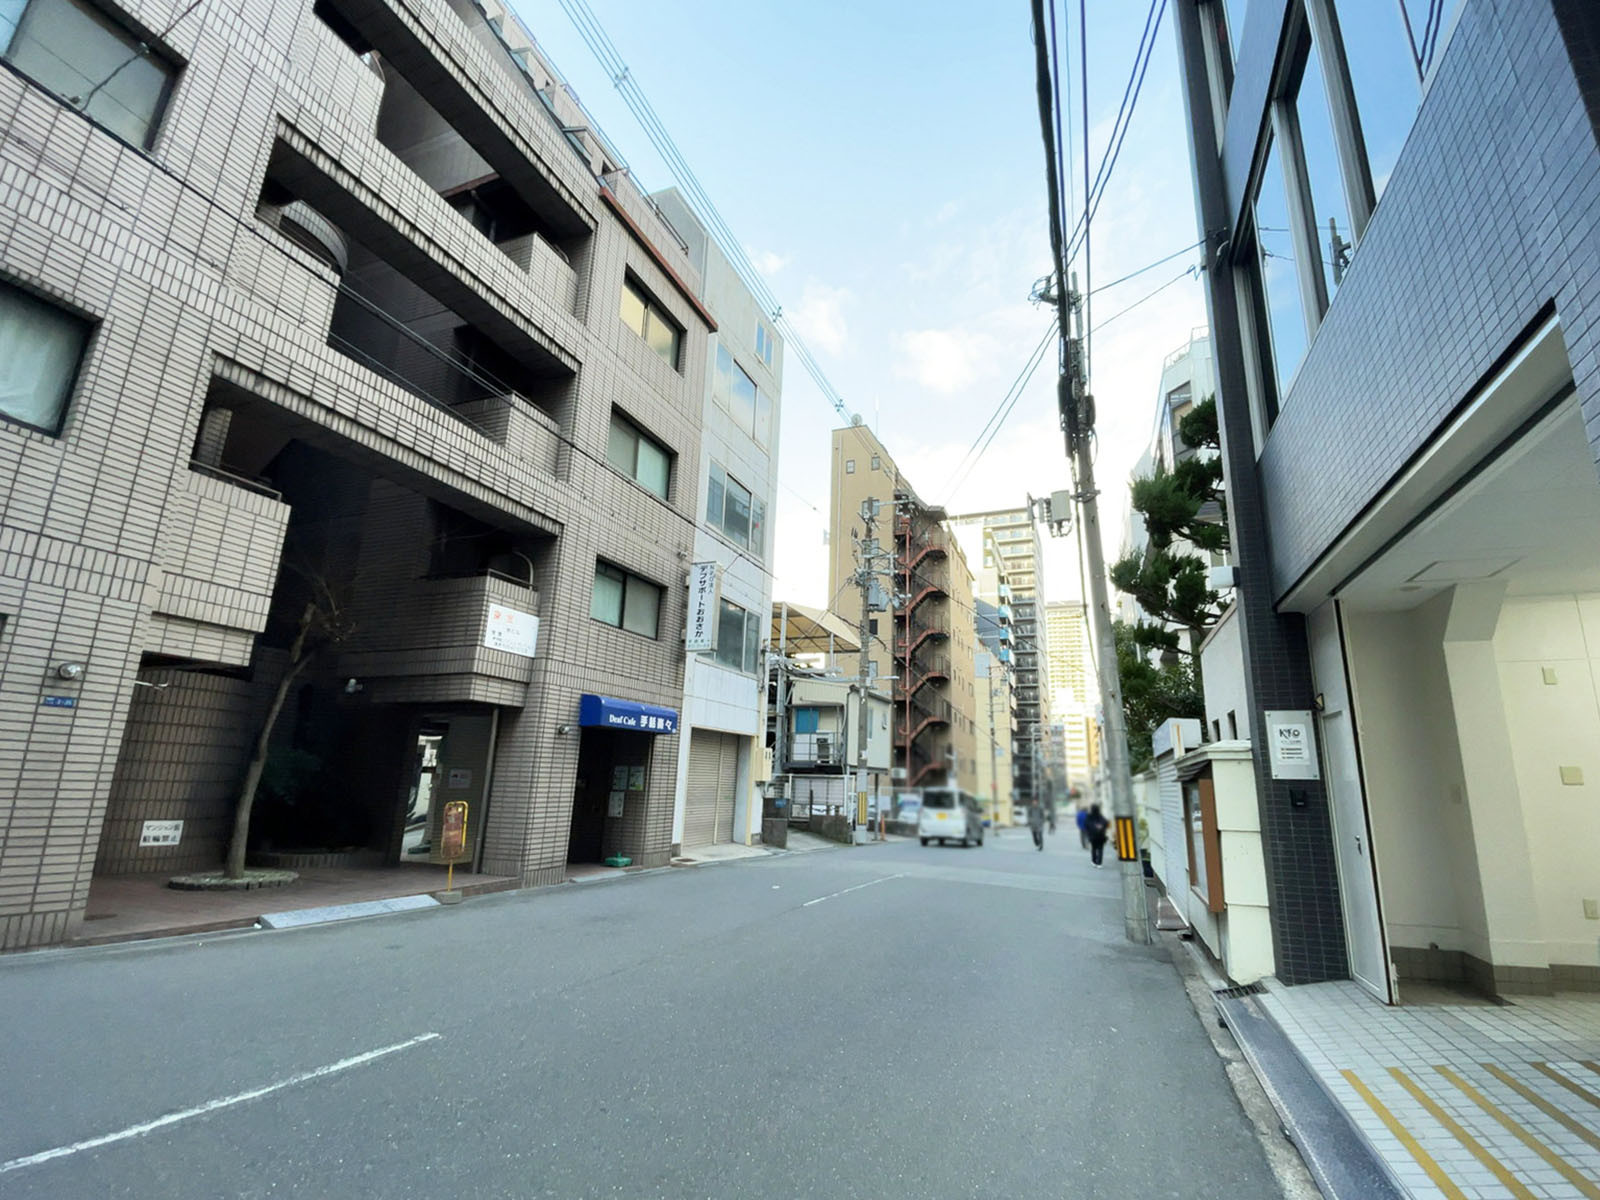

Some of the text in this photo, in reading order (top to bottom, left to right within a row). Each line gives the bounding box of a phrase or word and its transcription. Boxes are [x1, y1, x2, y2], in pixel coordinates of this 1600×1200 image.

[695, 565, 708, 638] デフサポートおおさか
[609, 713, 623, 724] Deaf
[623, 716, 636, 726] Cafe
